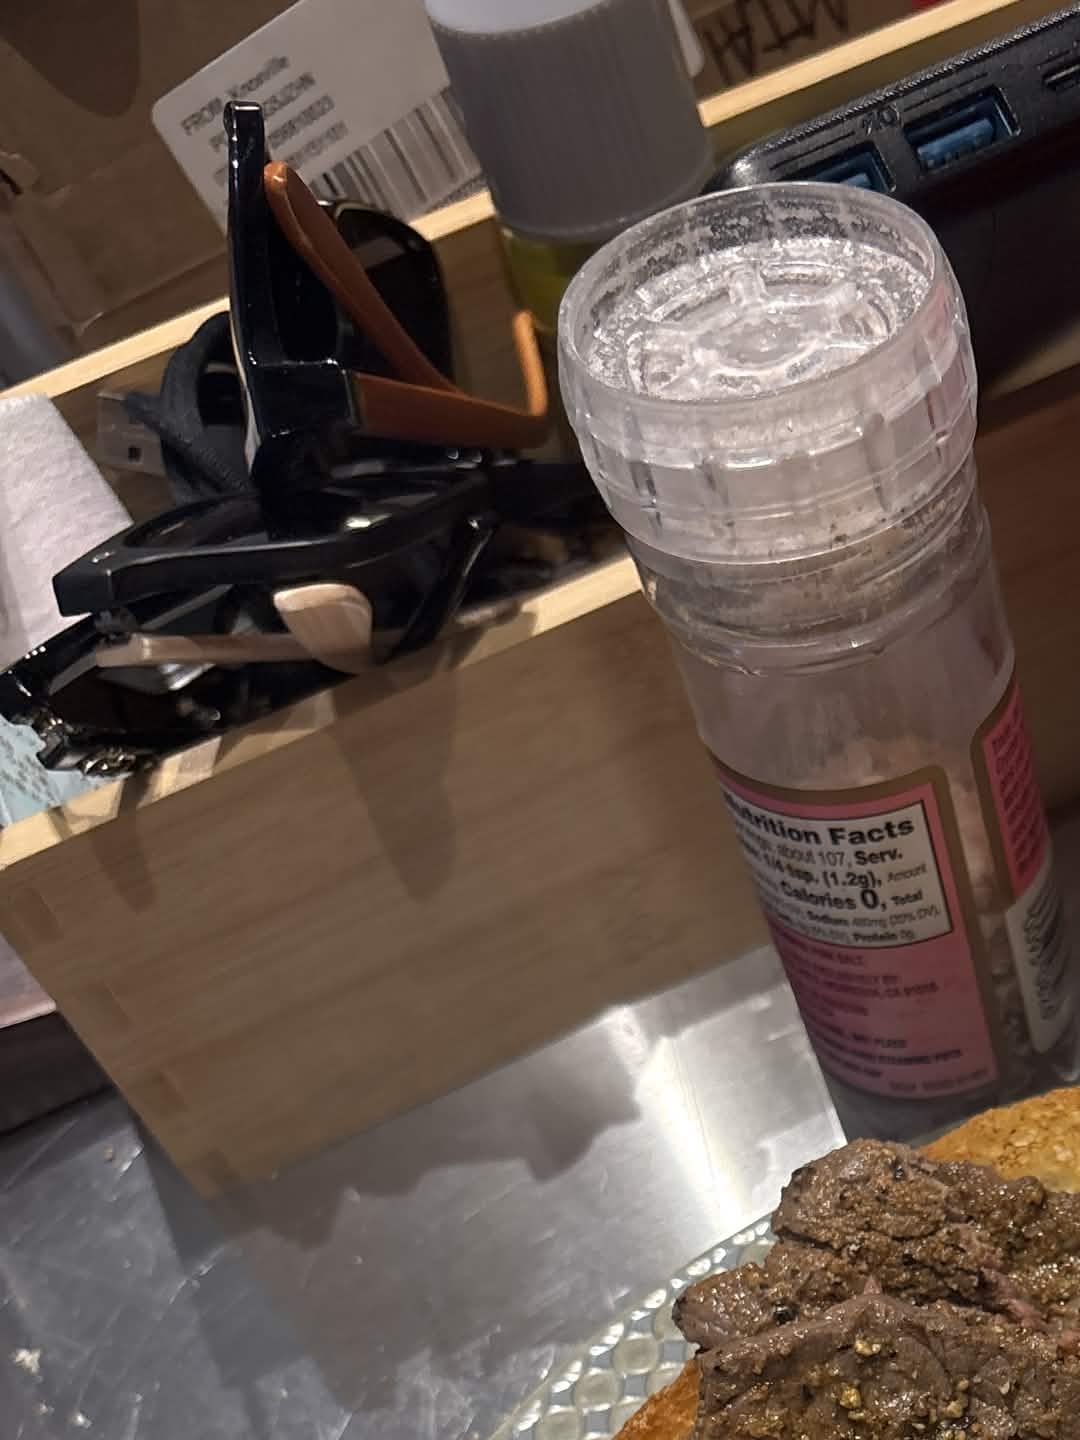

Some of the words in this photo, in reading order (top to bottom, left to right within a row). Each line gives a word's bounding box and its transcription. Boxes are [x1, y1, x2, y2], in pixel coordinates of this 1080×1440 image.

[827, 818, 915, 846] Facts
[855, 847, 903, 866] Serv.
[780, 880, 857, 910] Calories
